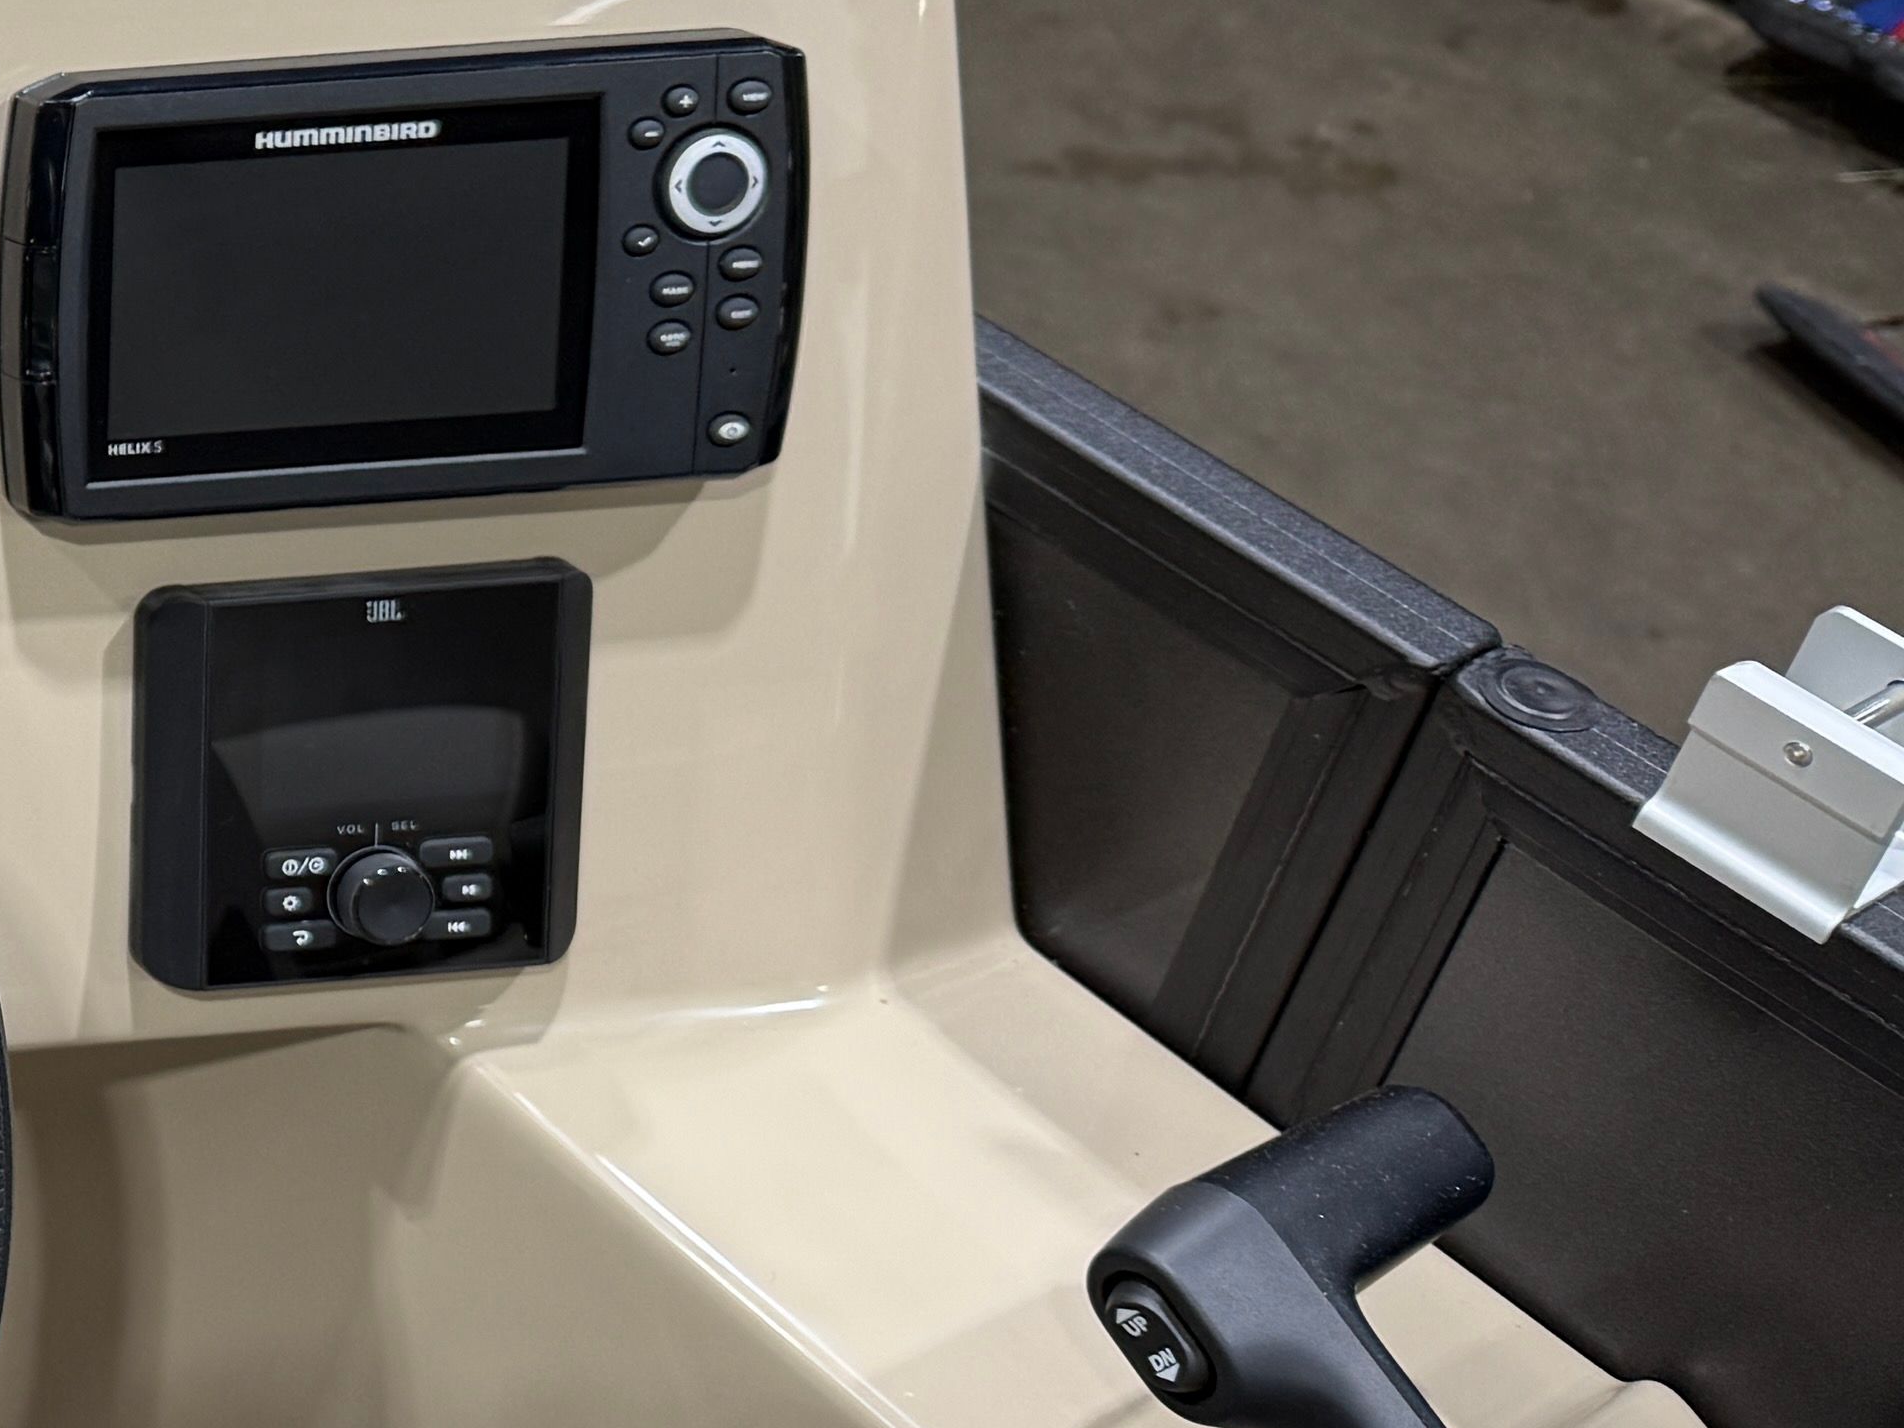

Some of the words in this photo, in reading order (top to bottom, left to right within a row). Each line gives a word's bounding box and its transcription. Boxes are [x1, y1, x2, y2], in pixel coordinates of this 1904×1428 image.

[107, 441, 152, 456] HELIX
[366, 599, 403, 623] JBL
[337, 824, 365, 835] VOL
[1121, 1315, 1148, 1337] UP
[1148, 1347, 1177, 1372] DN
